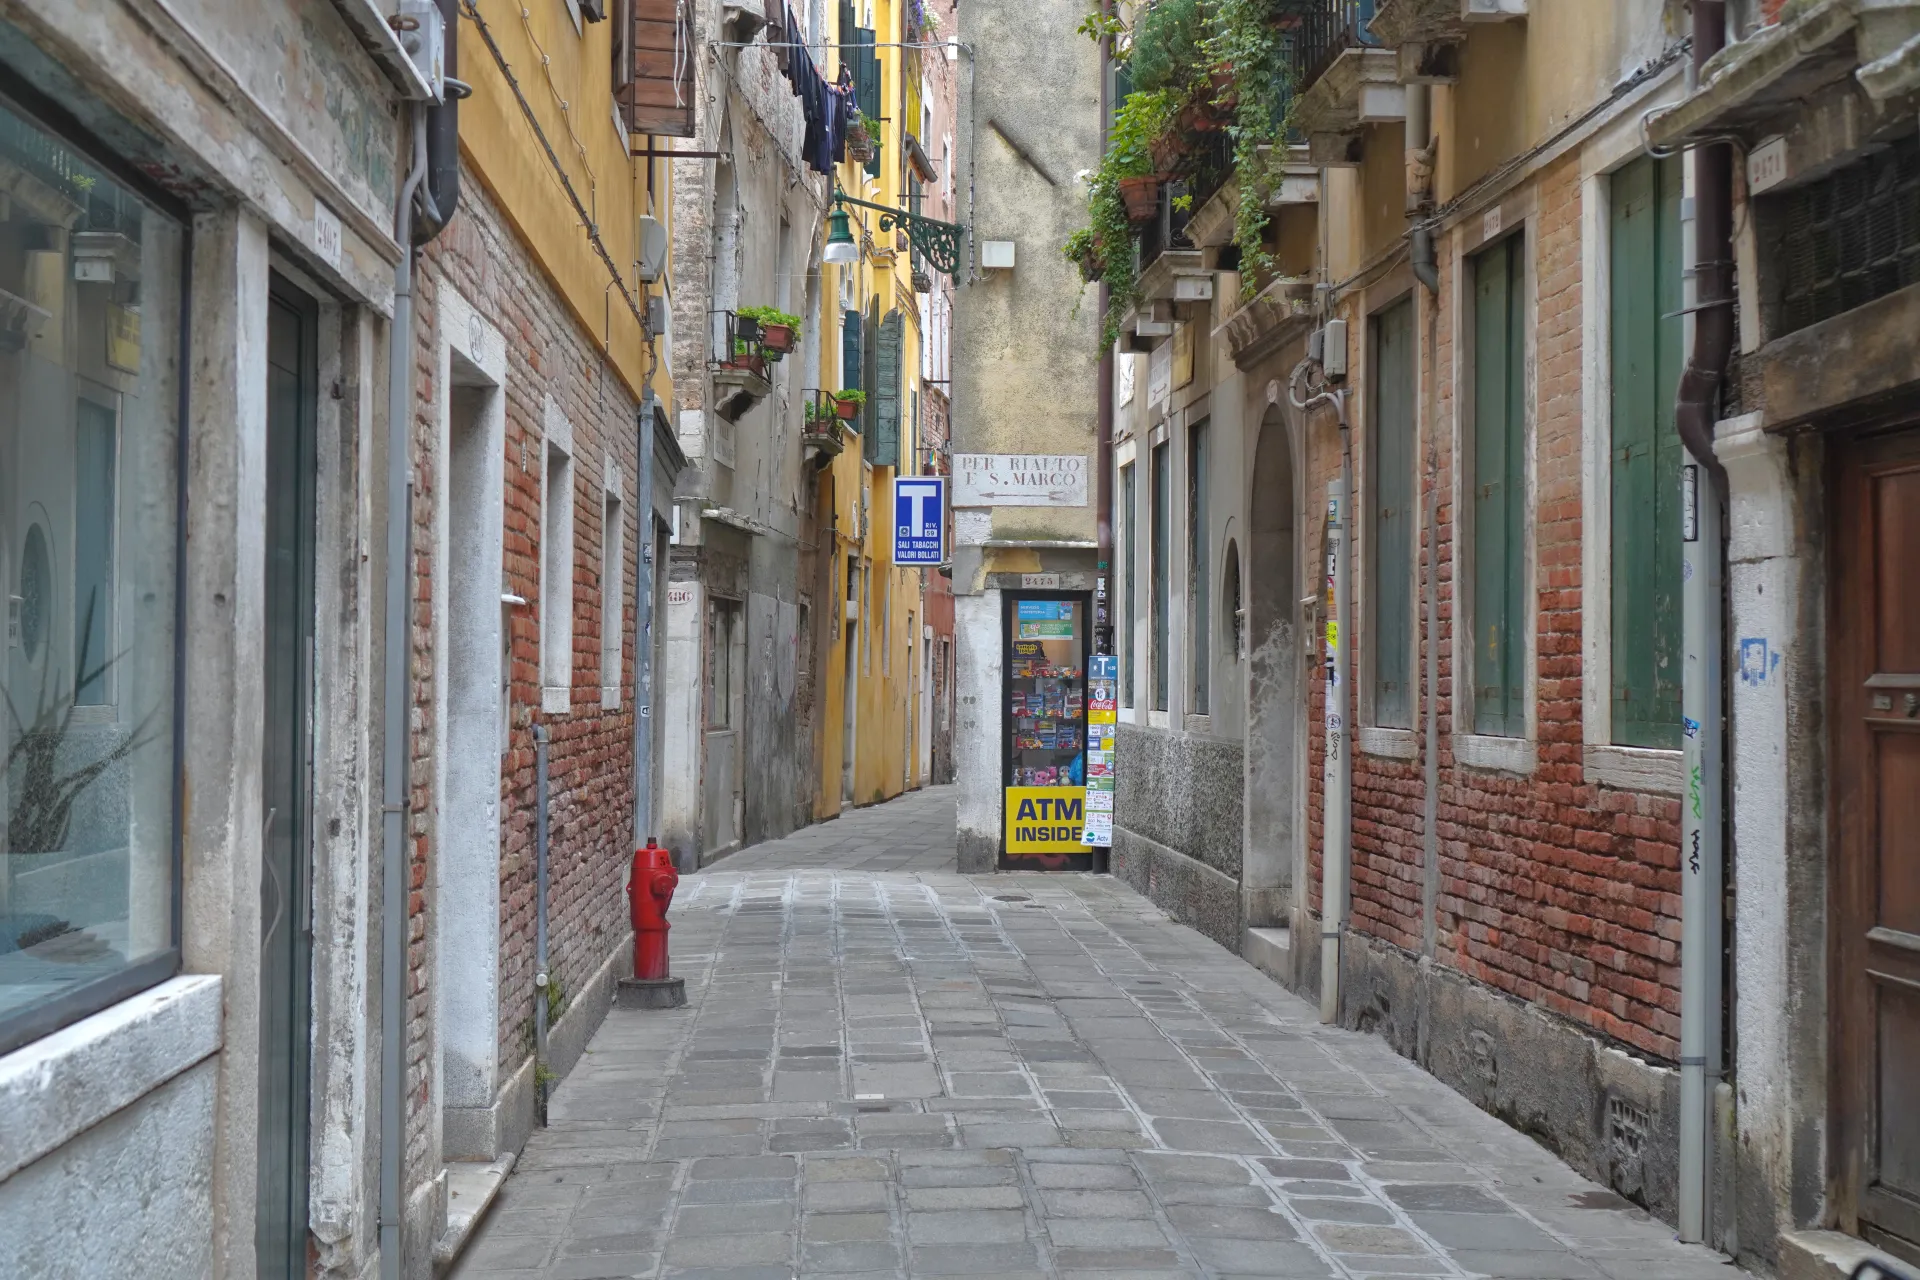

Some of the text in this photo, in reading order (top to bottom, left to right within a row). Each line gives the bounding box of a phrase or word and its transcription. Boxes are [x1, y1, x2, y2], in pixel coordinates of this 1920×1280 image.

[1752, 152, 1780, 184] 2471
[962, 456, 1080, 472] PER RIALTO
[965, 471, 977, 486] E
[899, 485, 937, 537] T
[898, 540, 939, 549] SALI TABACCHI
[897, 550, 939, 559] VALORI BOLLATI
[1025, 576, 1053, 586] 2475
[1097, 657, 1109, 676] T
[1015, 798, 1083, 821] ATM
[1015, 826, 1083, 842] INSIDE
